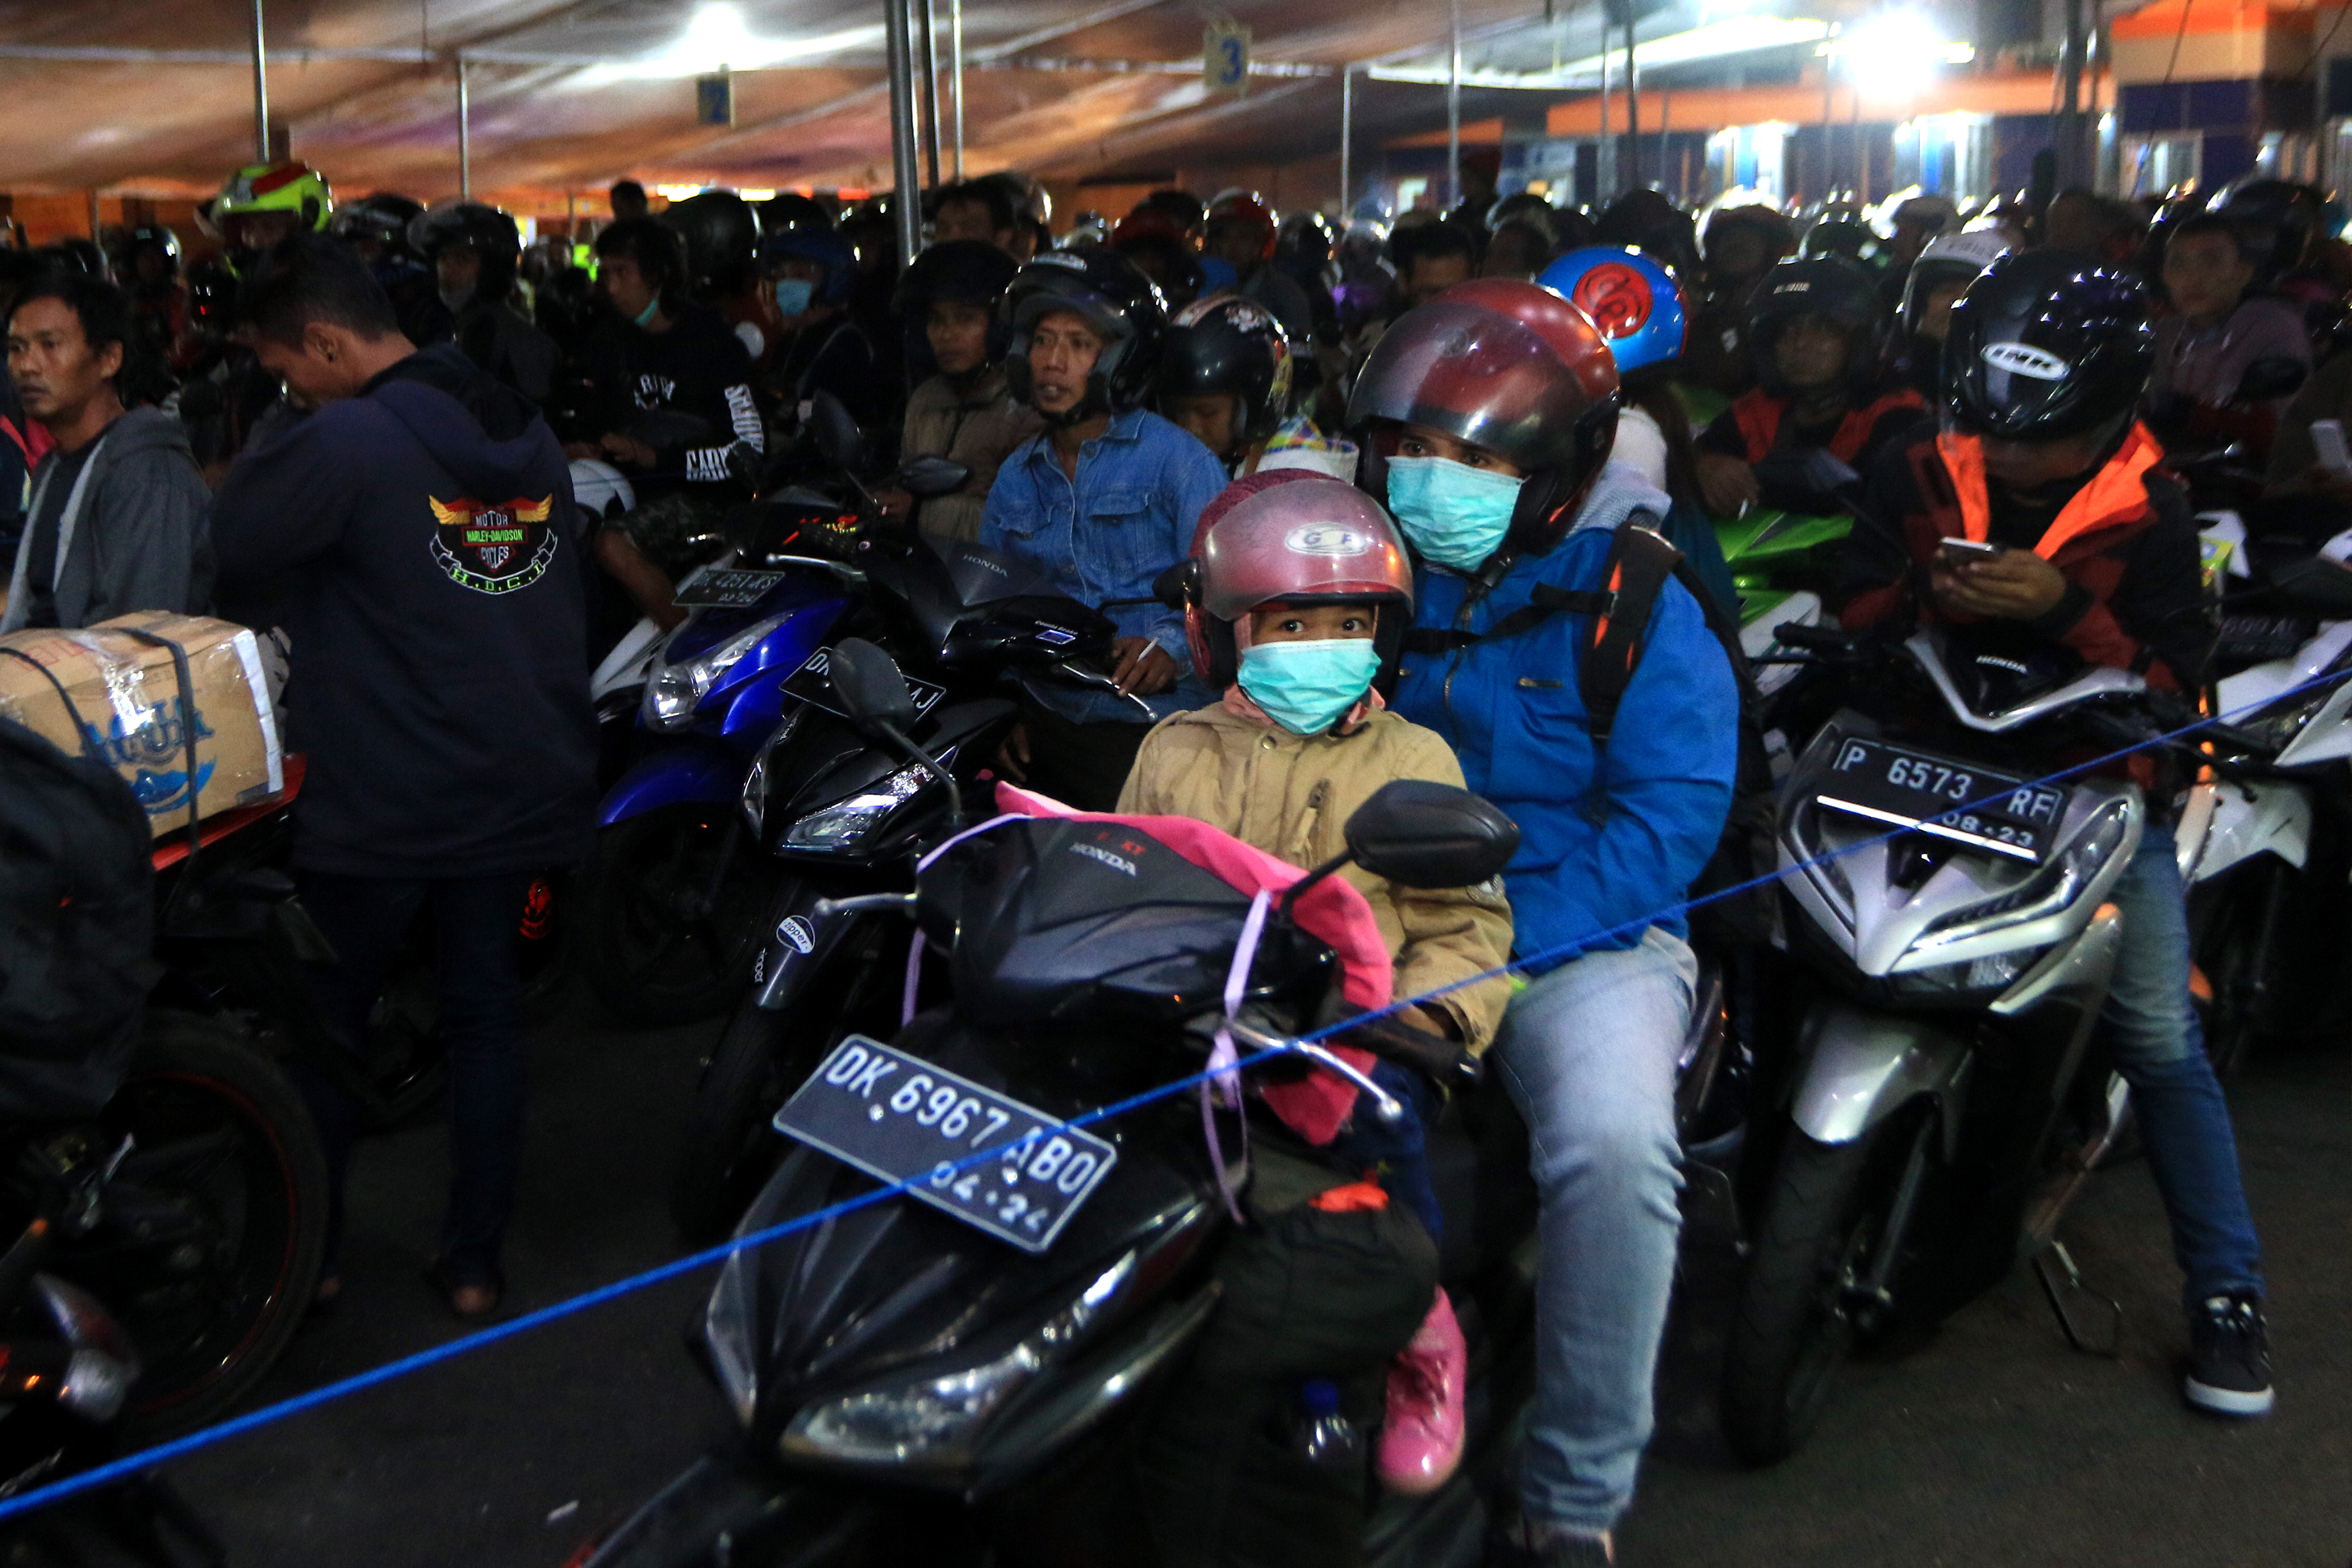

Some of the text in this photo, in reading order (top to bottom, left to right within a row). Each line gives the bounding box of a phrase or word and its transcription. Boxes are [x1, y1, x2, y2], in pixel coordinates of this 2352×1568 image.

[1221, 39, 1242, 83] 3
[476, 510, 509, 526] MOTOR
[466, 529, 523, 543] HARLEY-DAVIDSON
[480, 546, 510, 569] CYCLES
[963, 554, 1008, 577] HONDA
[1840, 745, 1867, 772] P
[1886, 757, 1974, 800] 6573
[1069, 842, 1137, 877] HONDA
[784, 921, 808, 945] zipper
[825, 1045, 898, 1099] DK
[890, 1074, 1011, 1149] 6967
